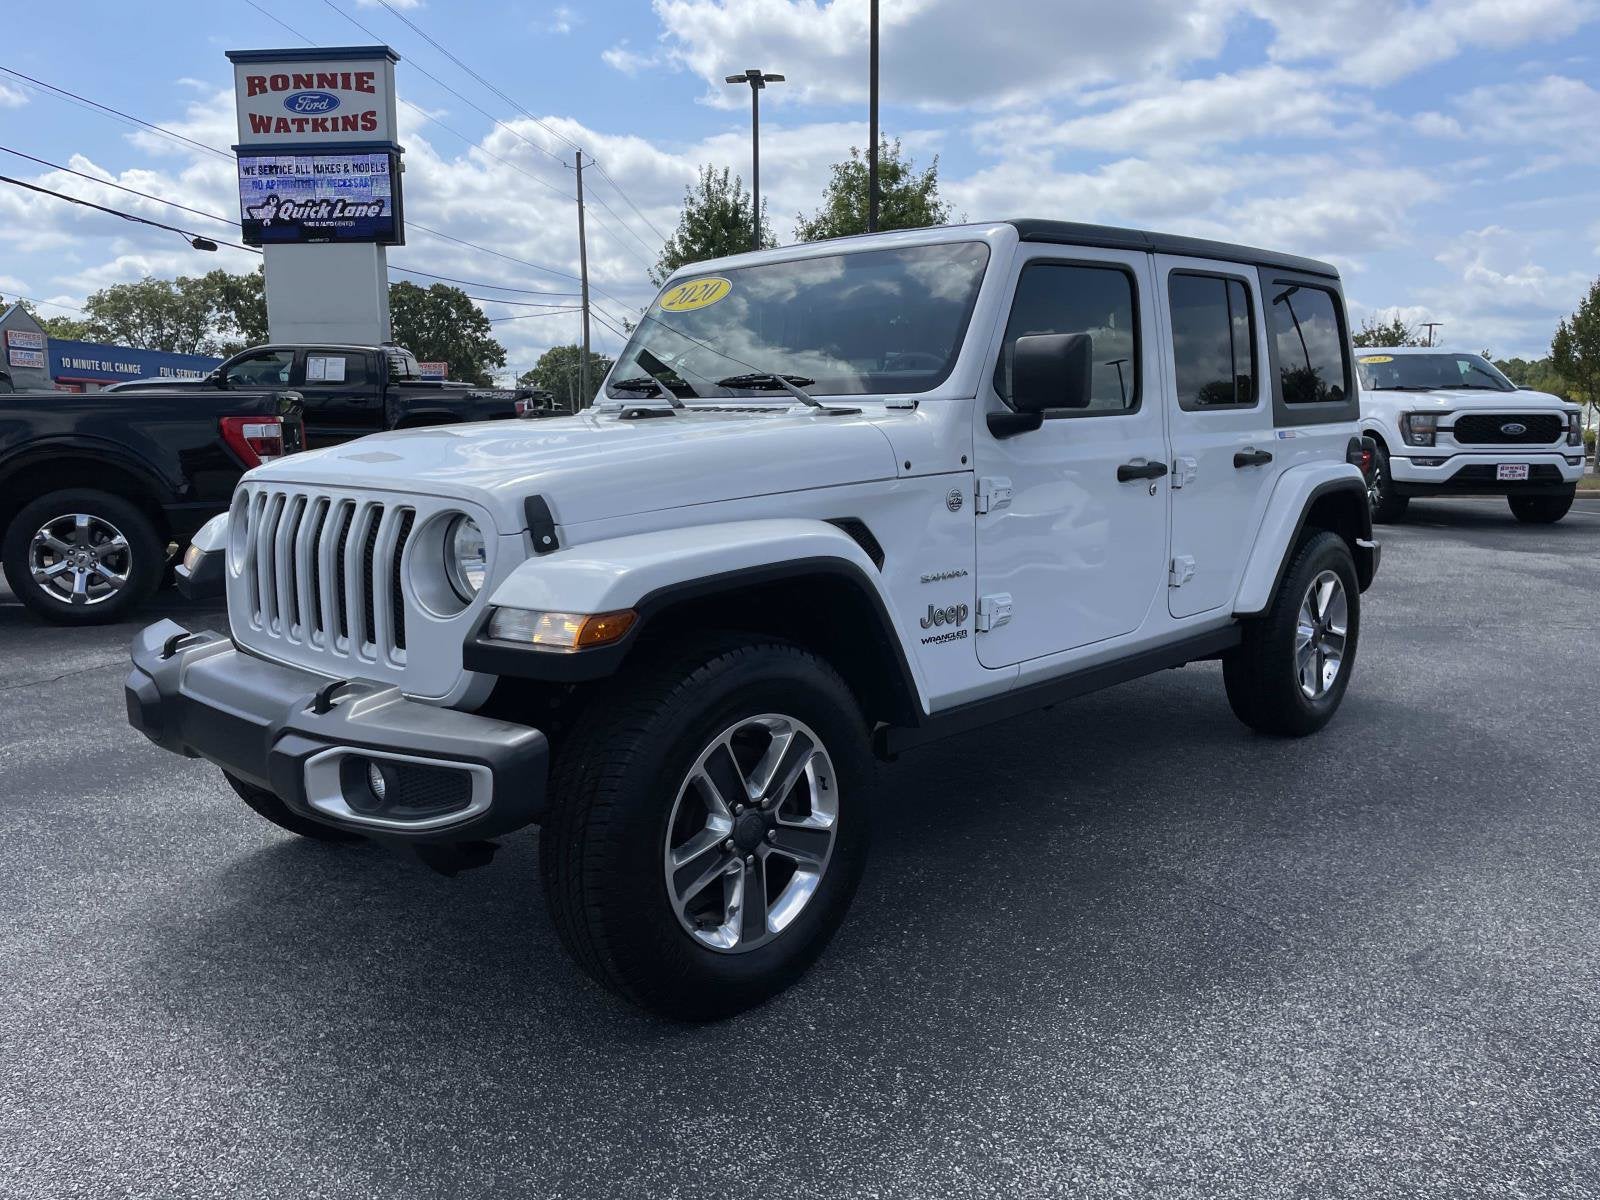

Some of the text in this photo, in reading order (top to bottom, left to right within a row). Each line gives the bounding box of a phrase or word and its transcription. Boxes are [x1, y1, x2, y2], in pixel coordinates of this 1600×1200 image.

[246, 72, 376, 97] RONNIE
[295, 95, 329, 111] Ford
[248, 110, 378, 134] WATKINS
[243, 162, 386, 175] WE SERVICE ALL MAKES & MODELS
[279, 202, 380, 220] Quick Lane
[666, 282, 722, 306] 2020
[62, 357, 71, 367] 10
[72, 359, 100, 371] MINUTE
[101, 362, 113, 372] OIL
[114, 363, 142, 374] CHANGE
[160, 367, 174, 378] FULL
[176, 369, 200, 379] SERVICE
[921, 570, 968, 584] SAHARA
[920, 604, 968, 629] Jeep
[921, 630, 967, 645] WRANGLER
